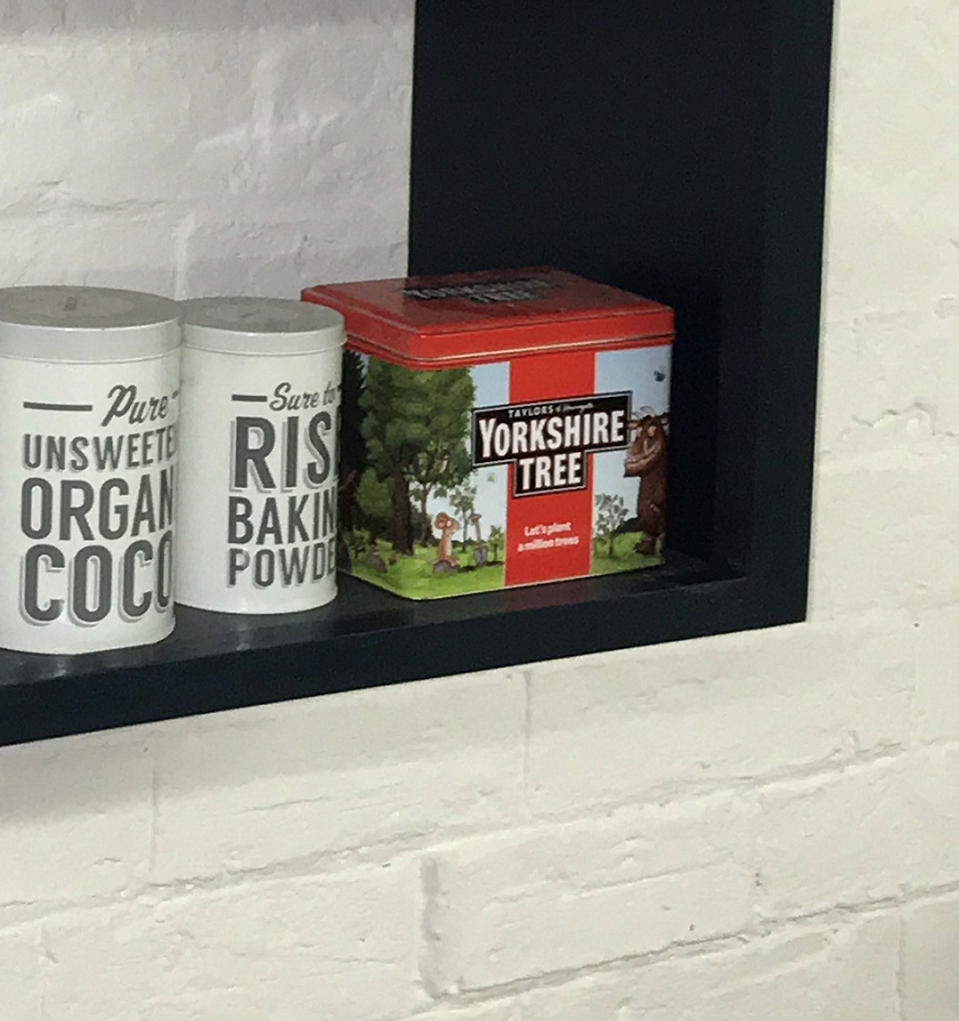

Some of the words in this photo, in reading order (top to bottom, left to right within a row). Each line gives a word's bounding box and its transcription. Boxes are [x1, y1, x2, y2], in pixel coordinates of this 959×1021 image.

[101, 384, 169, 427] Pure
[269, 382, 319, 412] Sure
[508, 404, 554, 418] TAYLORS
[229, 404, 340, 494] RIS
[478, 409, 625, 458] YORKSHIRE
[518, 451, 582, 491] TREE
